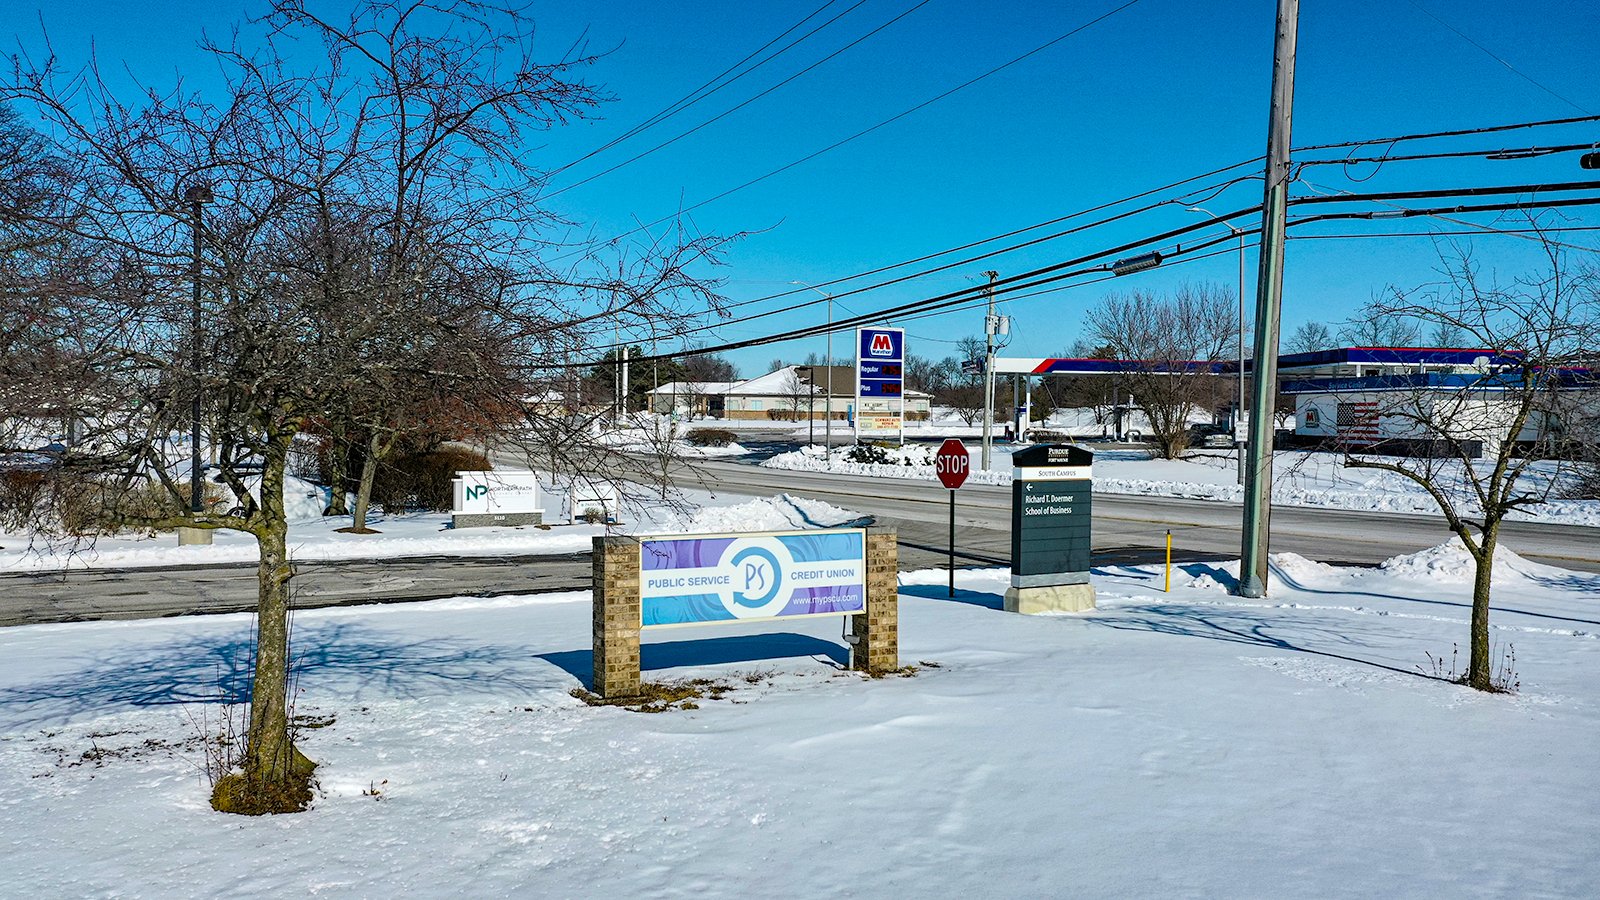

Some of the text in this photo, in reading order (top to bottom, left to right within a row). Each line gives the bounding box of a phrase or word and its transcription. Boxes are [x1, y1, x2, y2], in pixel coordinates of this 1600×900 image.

[873, 336, 891, 350] M
[937, 454, 968, 474] STOP
[466, 485, 488, 501] NP
[1026, 494, 1073, 504] Richard T. Doermer
[1026, 507, 1043, 515] School
[1050, 506, 1072, 514] Business
[745, 563, 765, 590] PS
[790, 568, 855, 581] CREDIT UNION
[648, 575, 730, 589] PUBLIC SERVICE
[792, 594, 858, 606] www.mypscu.com
